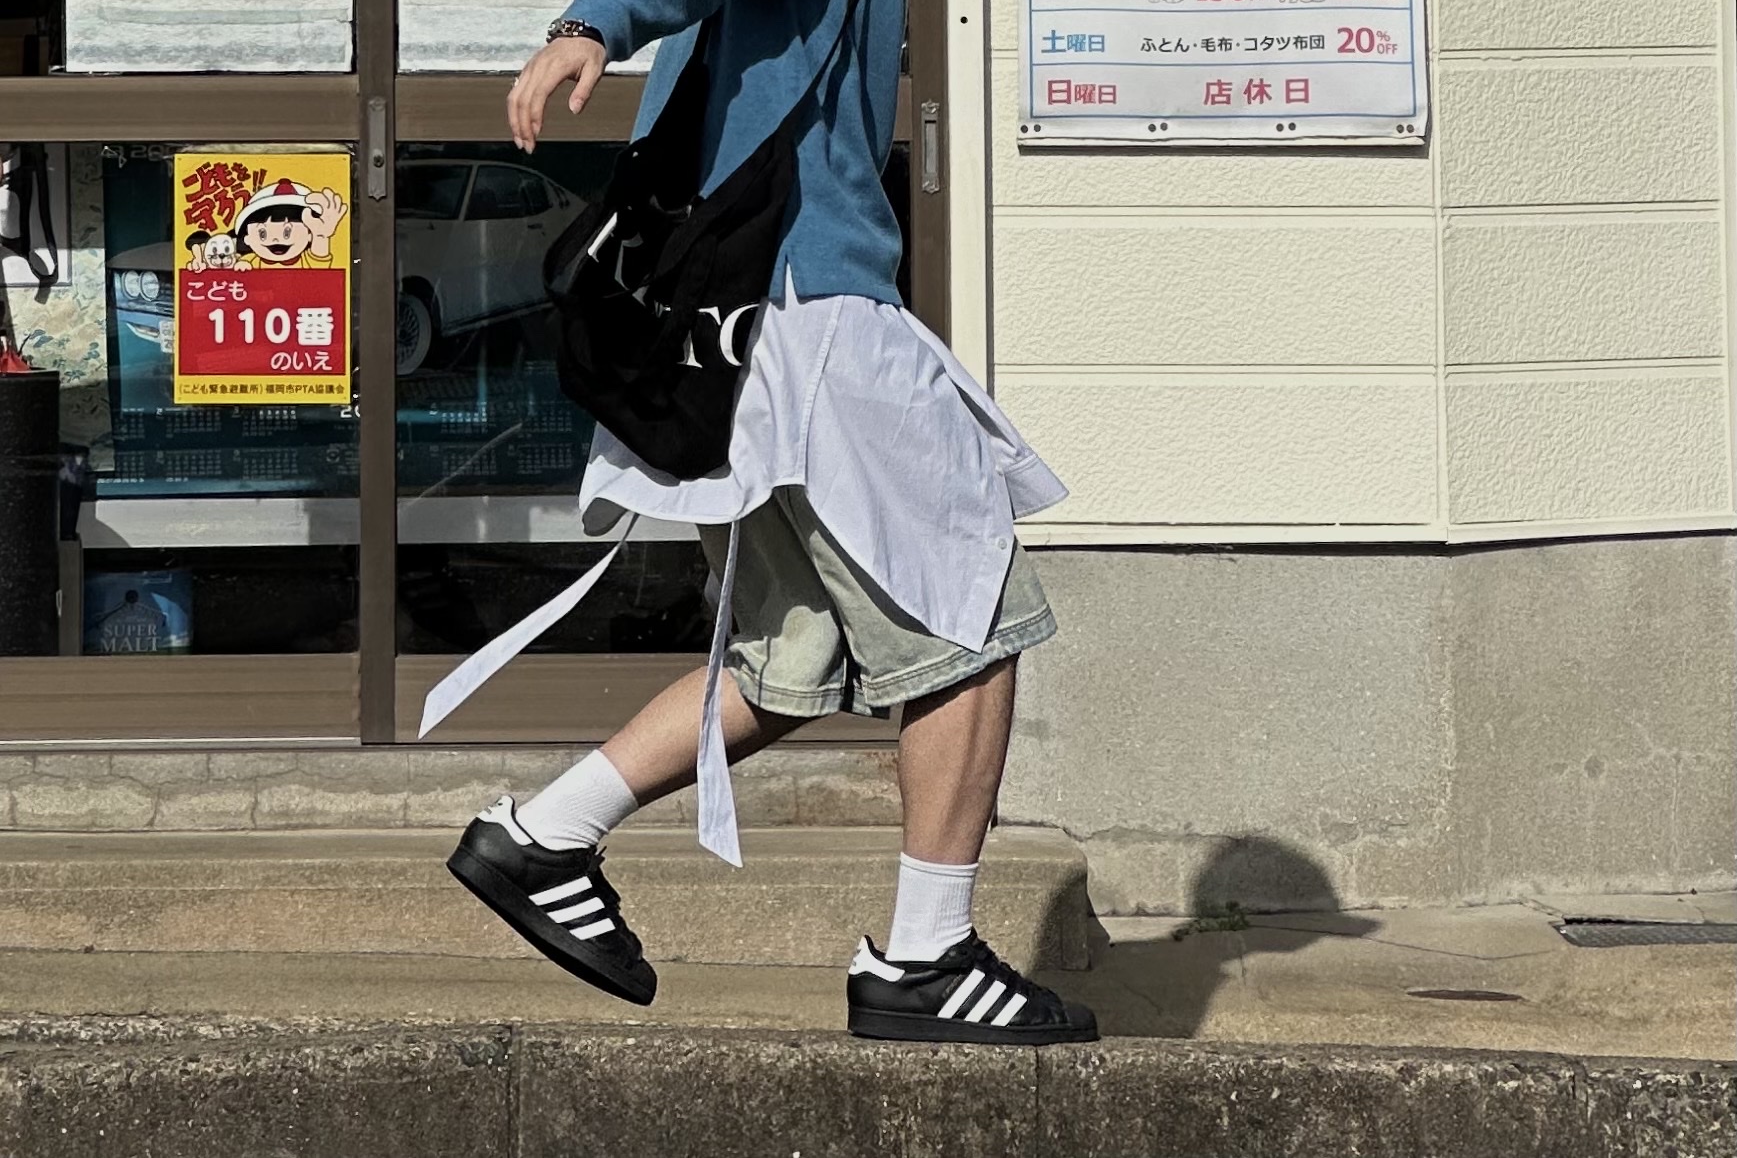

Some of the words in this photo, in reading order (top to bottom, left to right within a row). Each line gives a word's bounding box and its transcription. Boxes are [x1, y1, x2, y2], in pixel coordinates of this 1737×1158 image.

[1040, 29, 1105, 54] 土曜日
[1047, 79, 1117, 106] 日曜日
[1203, 78, 1310, 106] 店休日
[187, 280, 247, 301] こども
[208, 307, 334, 346] 110番
[270, 351, 332, 371] のいえ
[103, 624, 157, 637] SUPER
[100, 637, 160, 653] MALT
